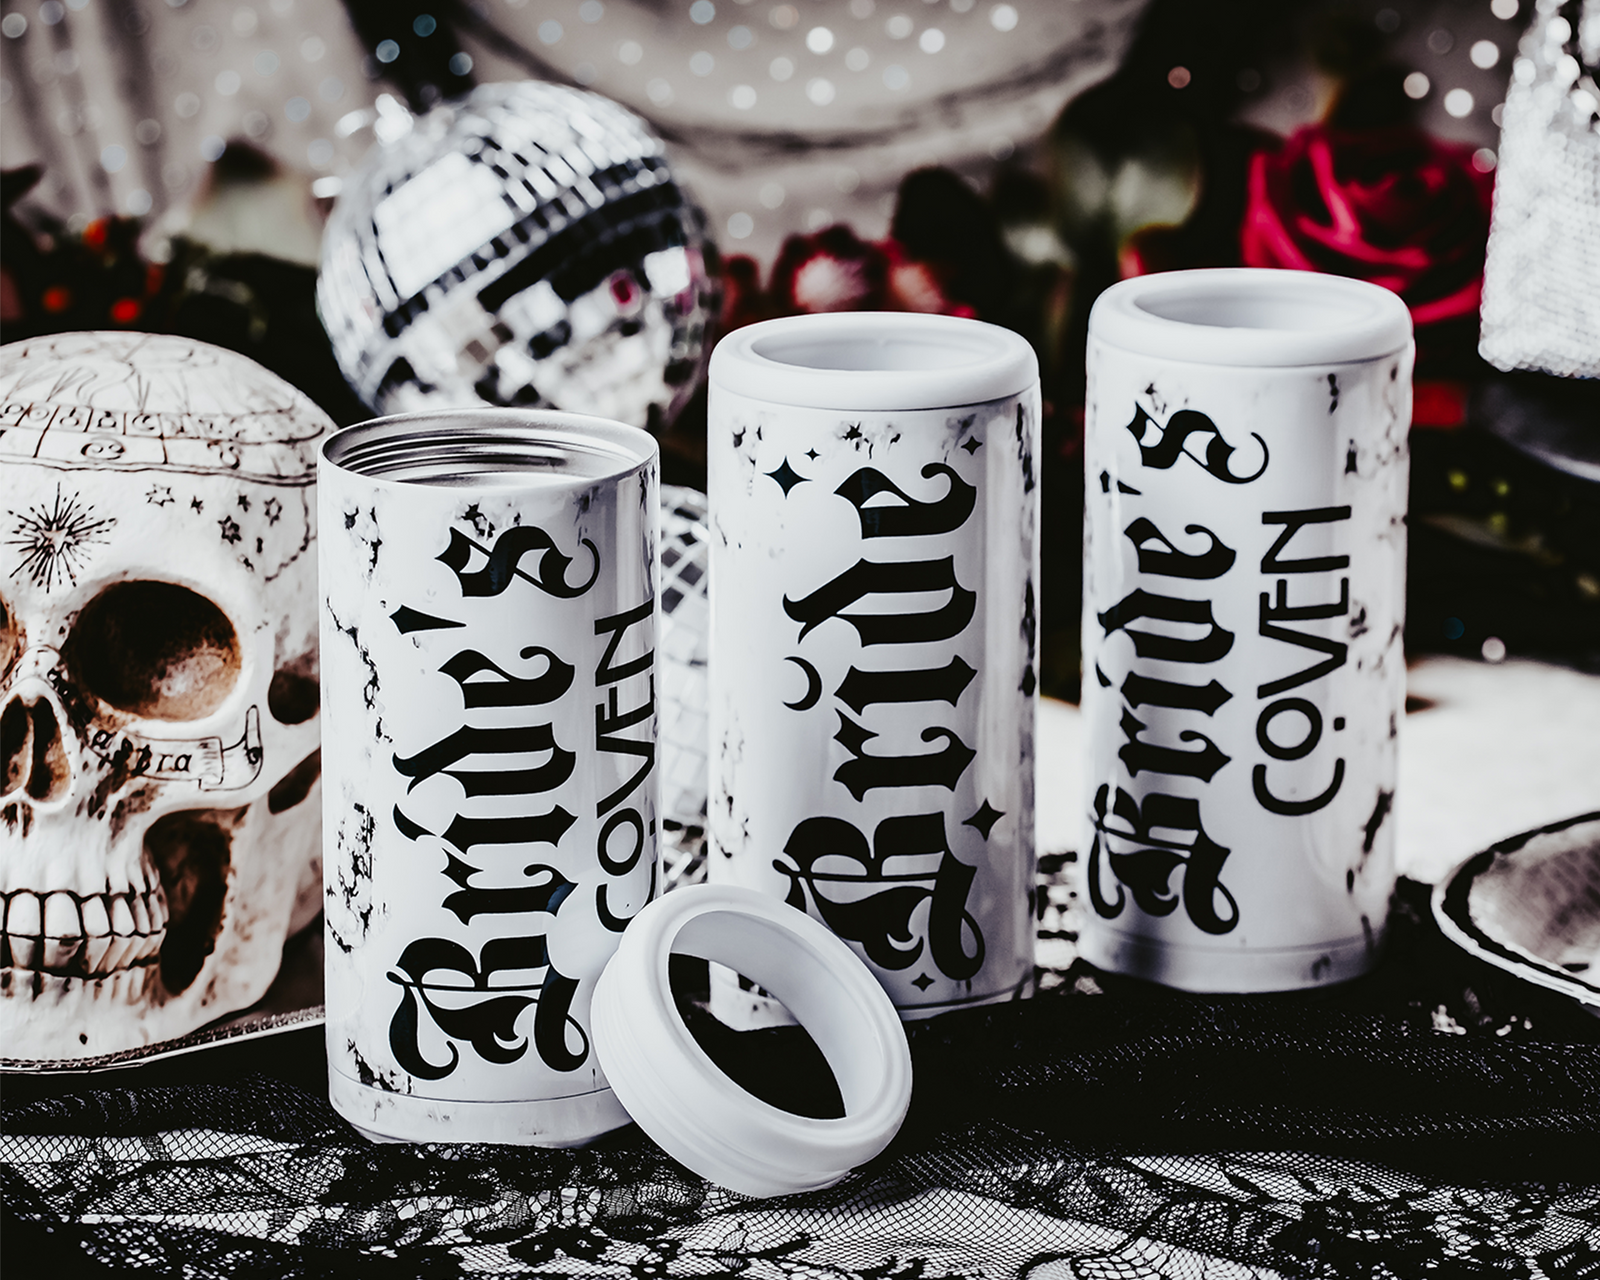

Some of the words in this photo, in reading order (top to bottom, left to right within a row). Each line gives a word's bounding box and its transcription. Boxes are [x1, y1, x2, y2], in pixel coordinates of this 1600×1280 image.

[386, 525, 600, 1081] Bride's
[594, 599, 656, 933] COVEN
[772, 461, 986, 982] Bride
[1088, 401, 1270, 935] Bride's
[1252, 505, 1352, 817] COVEN
